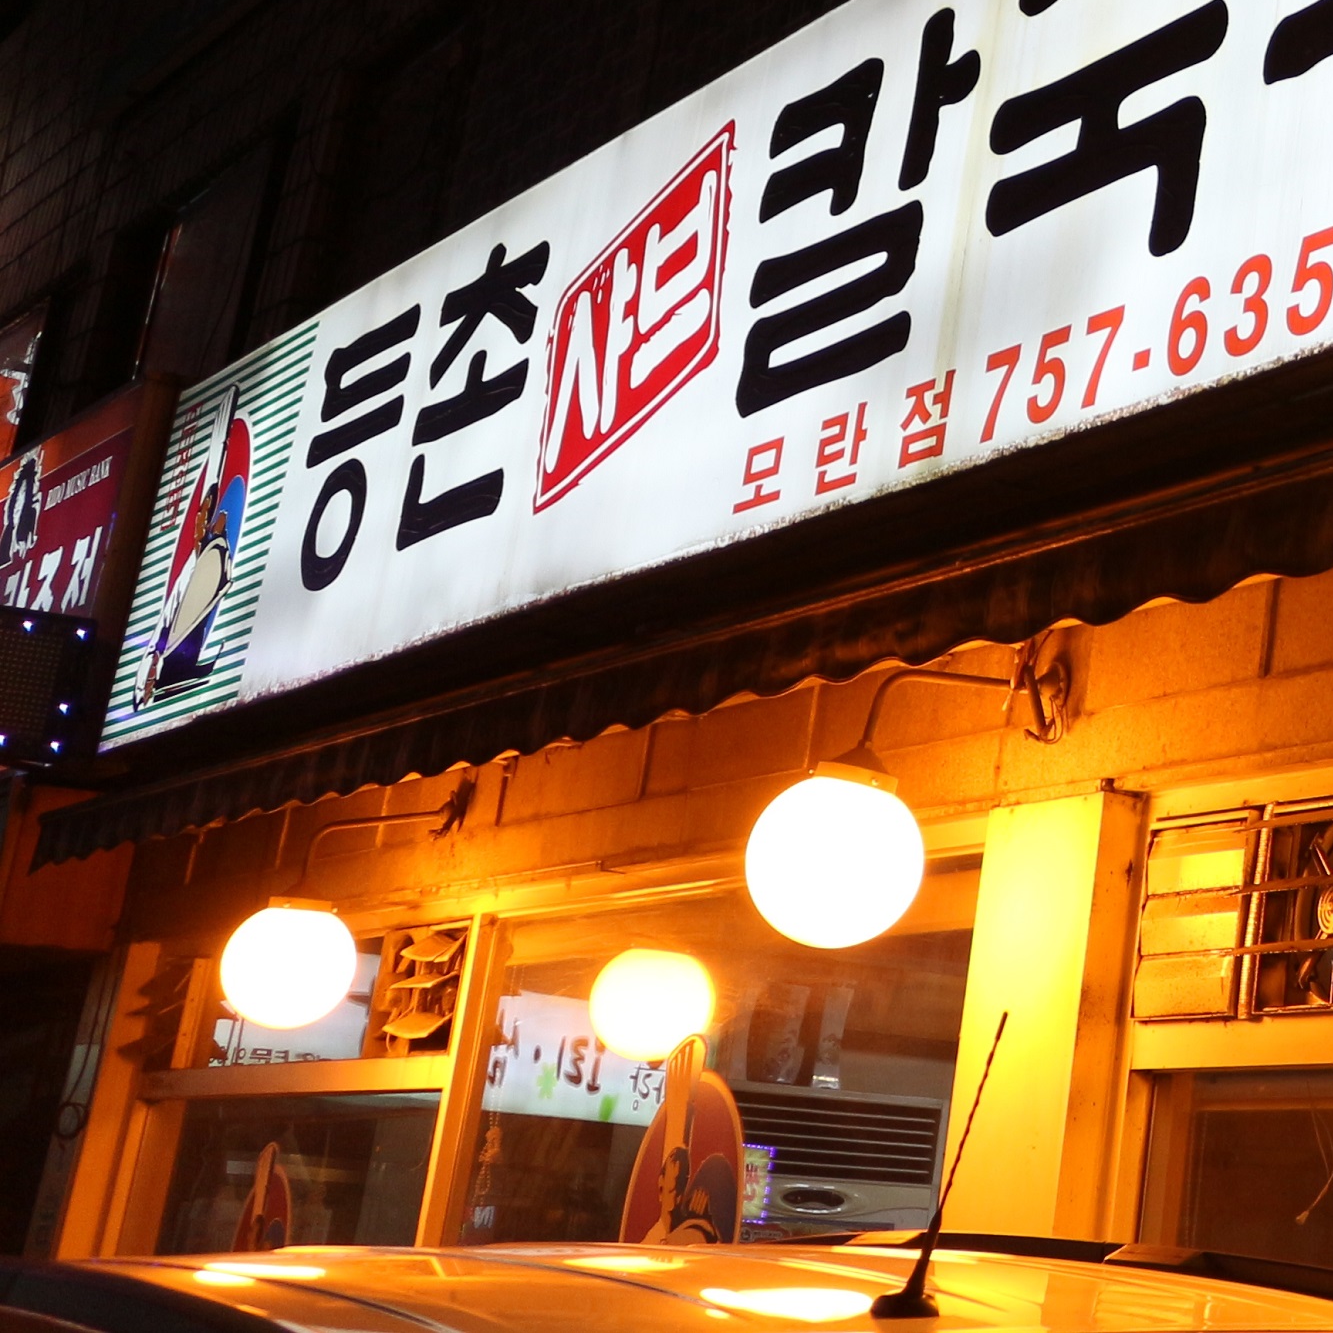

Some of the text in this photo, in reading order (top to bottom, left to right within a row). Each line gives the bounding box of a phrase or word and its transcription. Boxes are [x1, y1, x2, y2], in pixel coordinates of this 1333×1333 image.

[300, 241, 551, 591] 등촌
[545, 154, 718, 471] 샤브
[731, 367, 952, 515] 모란점
